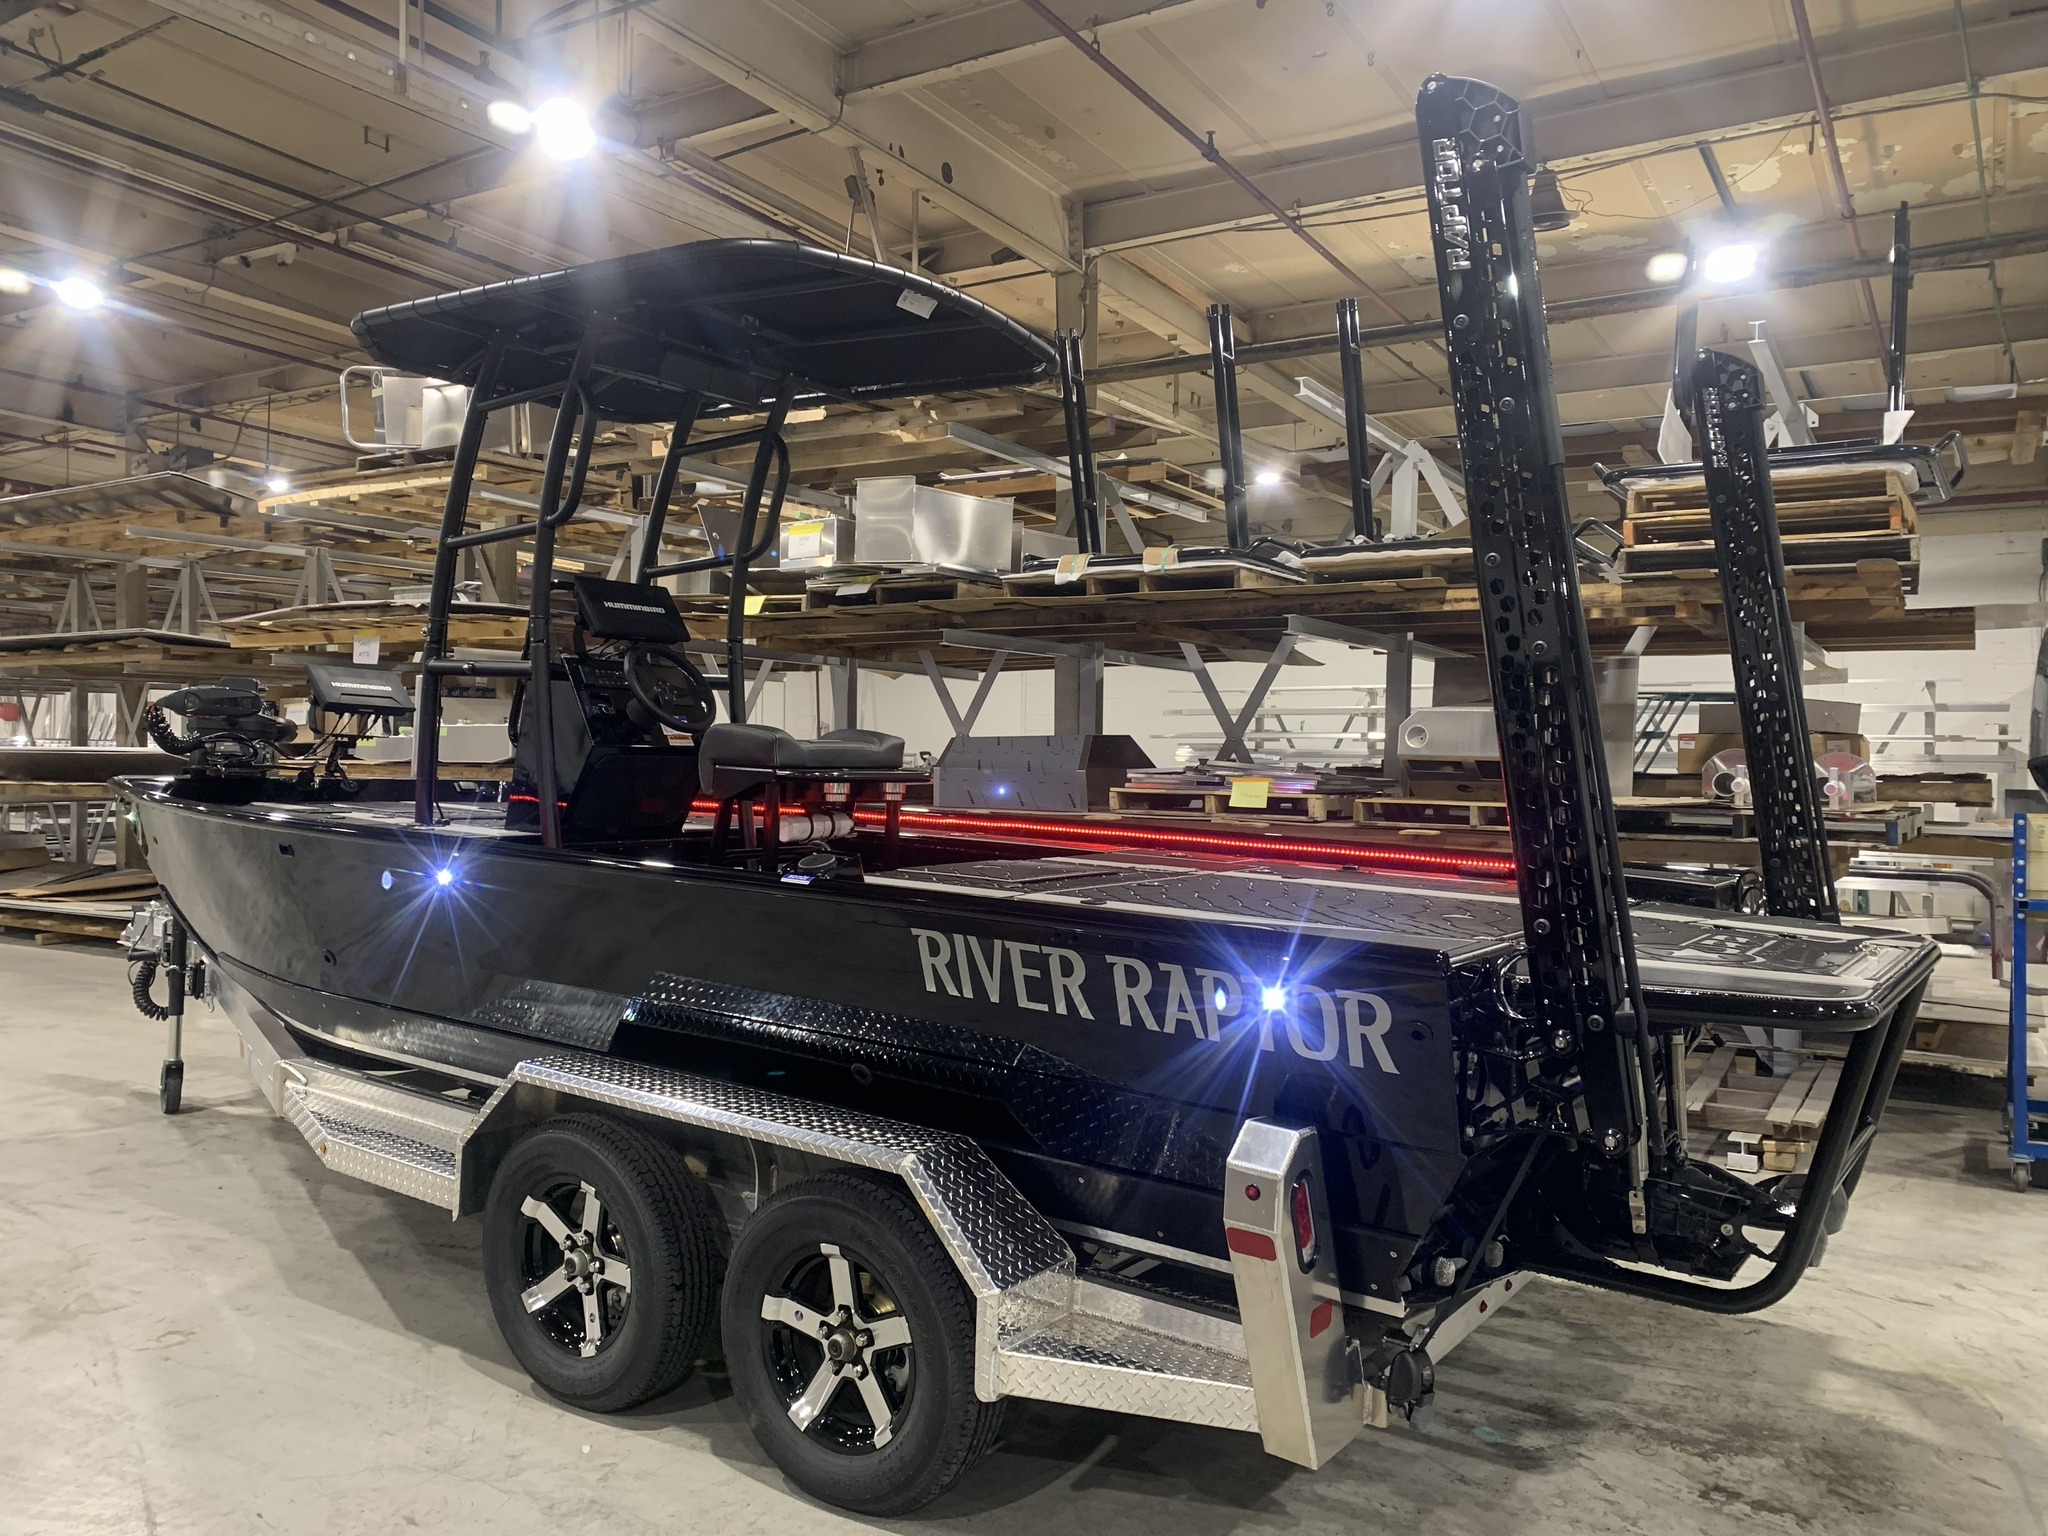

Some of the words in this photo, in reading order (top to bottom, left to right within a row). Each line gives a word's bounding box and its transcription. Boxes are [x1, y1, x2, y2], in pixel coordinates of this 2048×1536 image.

[1432, 138, 1471, 270] RAPTOR
[1702, 387, 1729, 468] RAPTOR
[603, 600, 666, 614] HUMMINBIRD
[910, 927, 1095, 1020] RIVER
[1105, 954, 1400, 1074] RAPTOR
